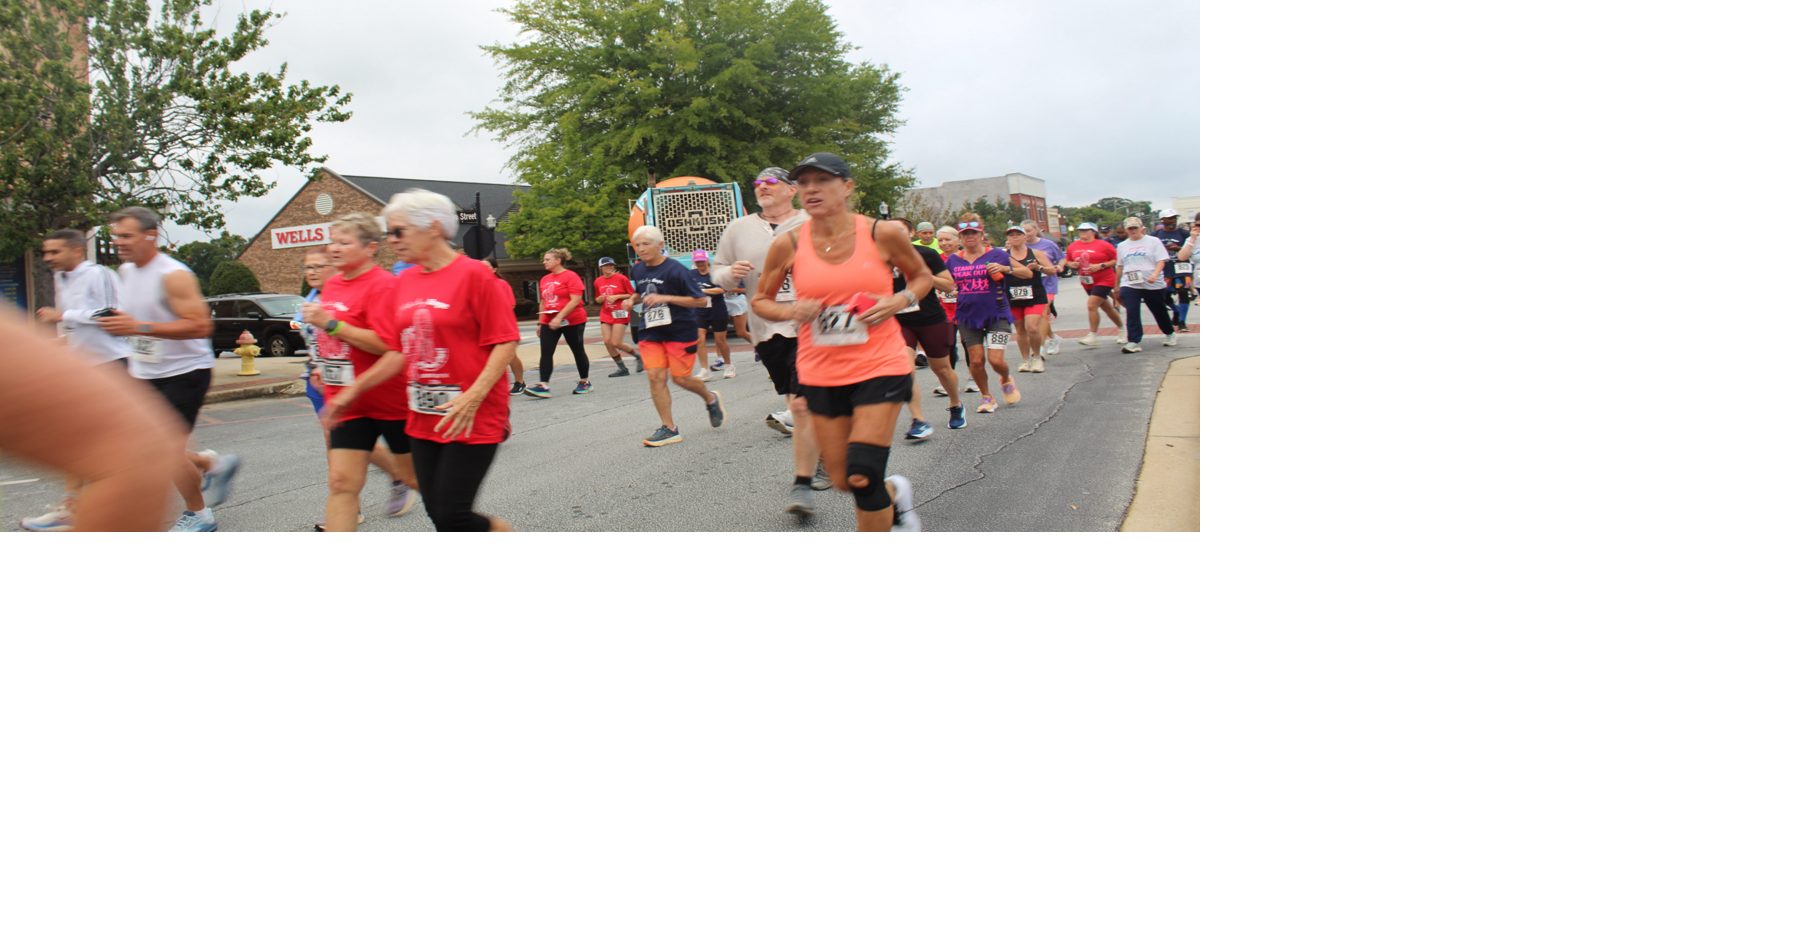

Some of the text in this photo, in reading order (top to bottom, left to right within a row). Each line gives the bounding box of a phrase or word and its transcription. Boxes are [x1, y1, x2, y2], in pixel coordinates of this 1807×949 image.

[459, 212, 477, 220] Street
[667, 215, 726, 228] OSHKOSH
[275, 227, 324, 244] WELLS
[953, 265, 975, 273] STAND
[1013, 288, 1028, 296] 879
